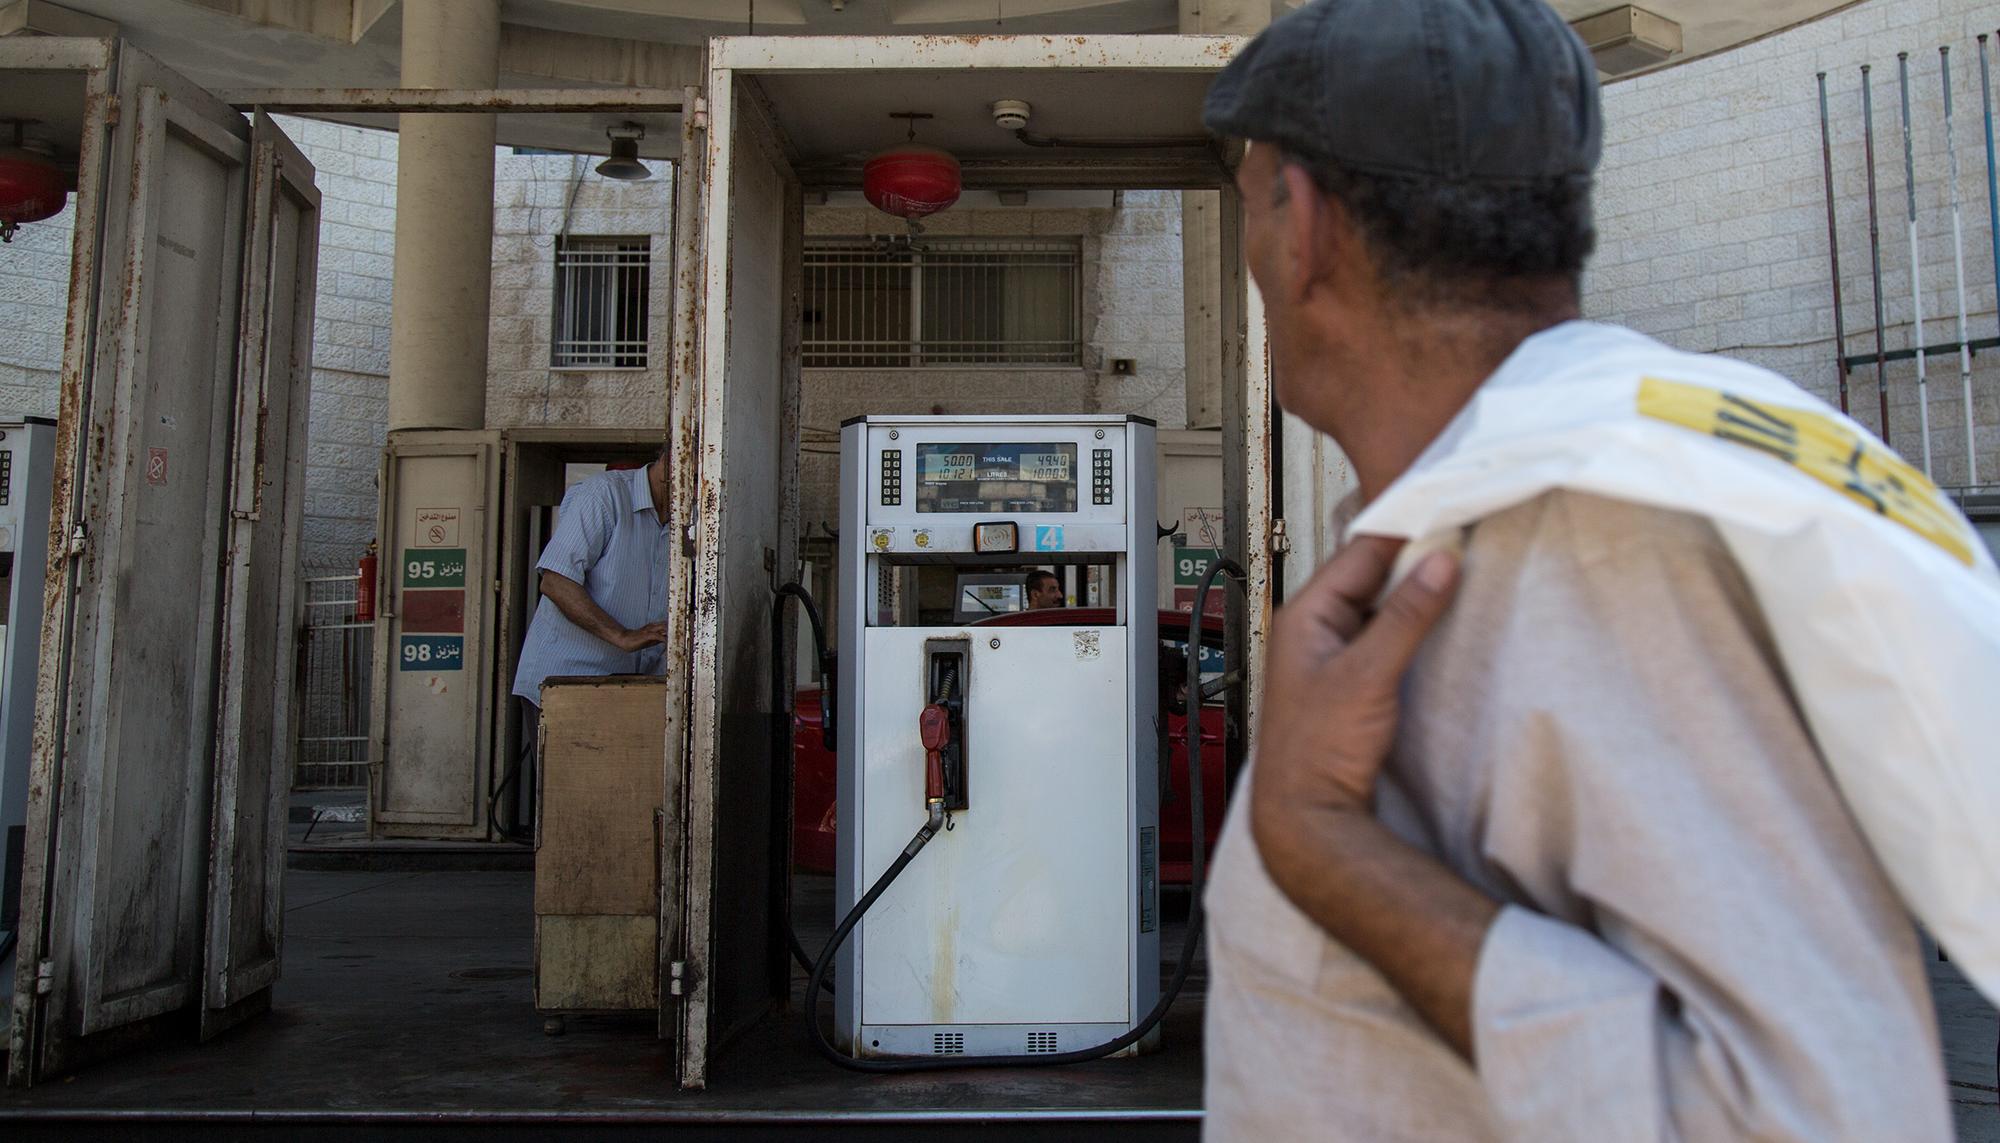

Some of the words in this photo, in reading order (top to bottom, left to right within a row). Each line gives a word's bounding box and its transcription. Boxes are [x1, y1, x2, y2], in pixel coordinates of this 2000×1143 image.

[943, 455, 973, 467] 50.00
[1038, 455, 1067, 467] 49.40
[1041, 527, 1058, 549] 4
[408, 560, 435, 579] 95
[440, 562, 464, 577] بنزين
[1180, 559, 1208, 577] 95
[404, 644, 431, 662] 98
[435, 645, 460, 660] بنزين
